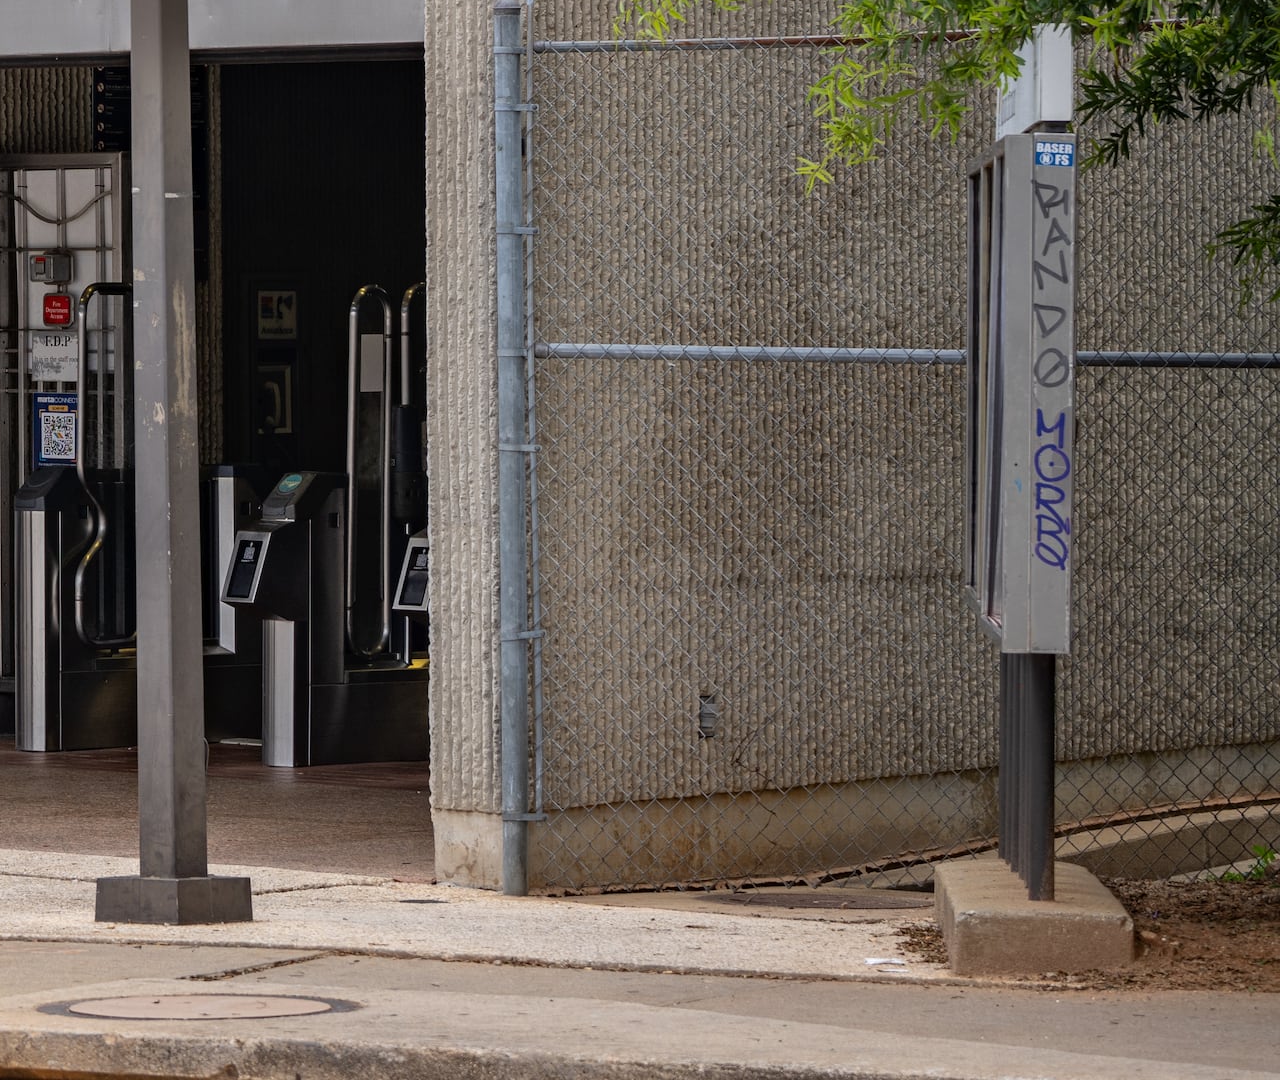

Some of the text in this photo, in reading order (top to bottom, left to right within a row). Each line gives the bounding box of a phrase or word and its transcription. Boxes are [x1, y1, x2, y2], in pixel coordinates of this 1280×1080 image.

[1035, 143, 1073, 155] BASER
[1055, 155, 1071, 166] FS
[46, 306, 69, 314] Department
